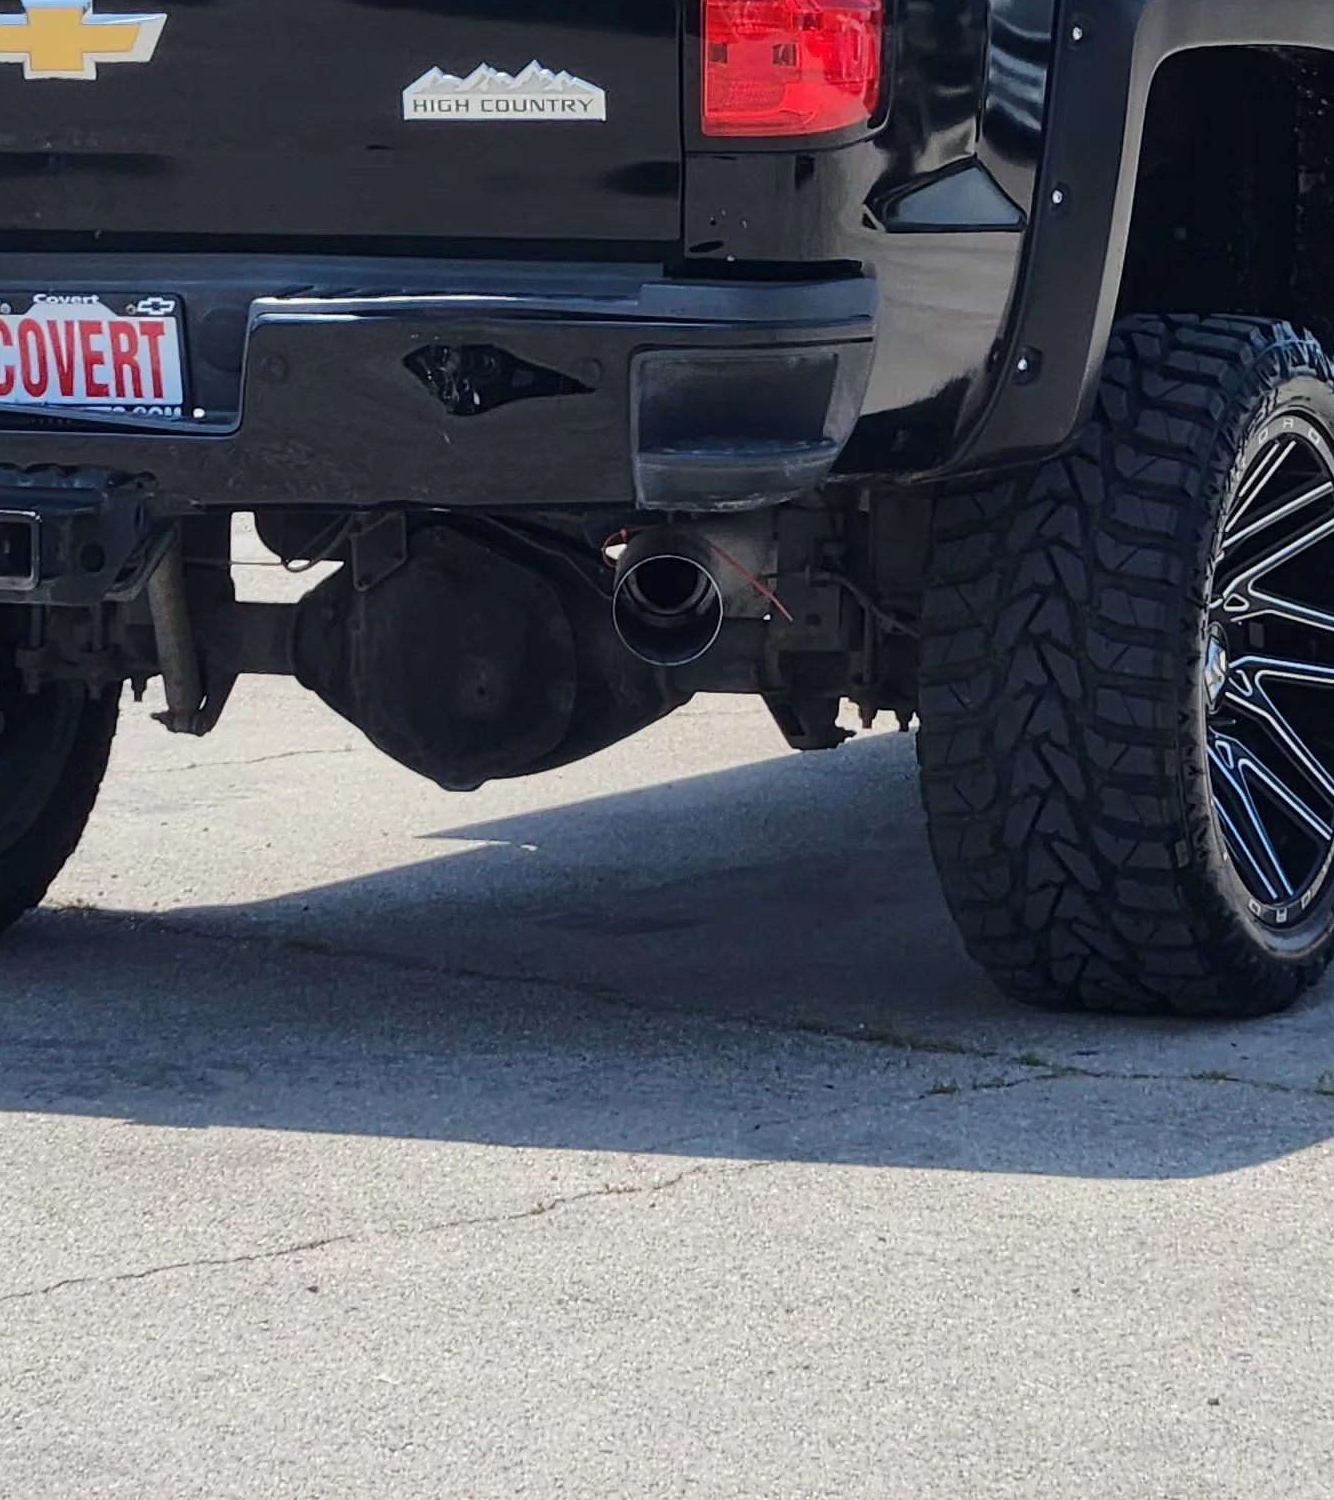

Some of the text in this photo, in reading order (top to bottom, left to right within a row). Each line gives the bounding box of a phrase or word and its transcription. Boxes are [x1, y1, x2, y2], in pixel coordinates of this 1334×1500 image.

[413, 99, 595, 113] HIGH COUNTRY
[33, 293, 100, 304] Covert
